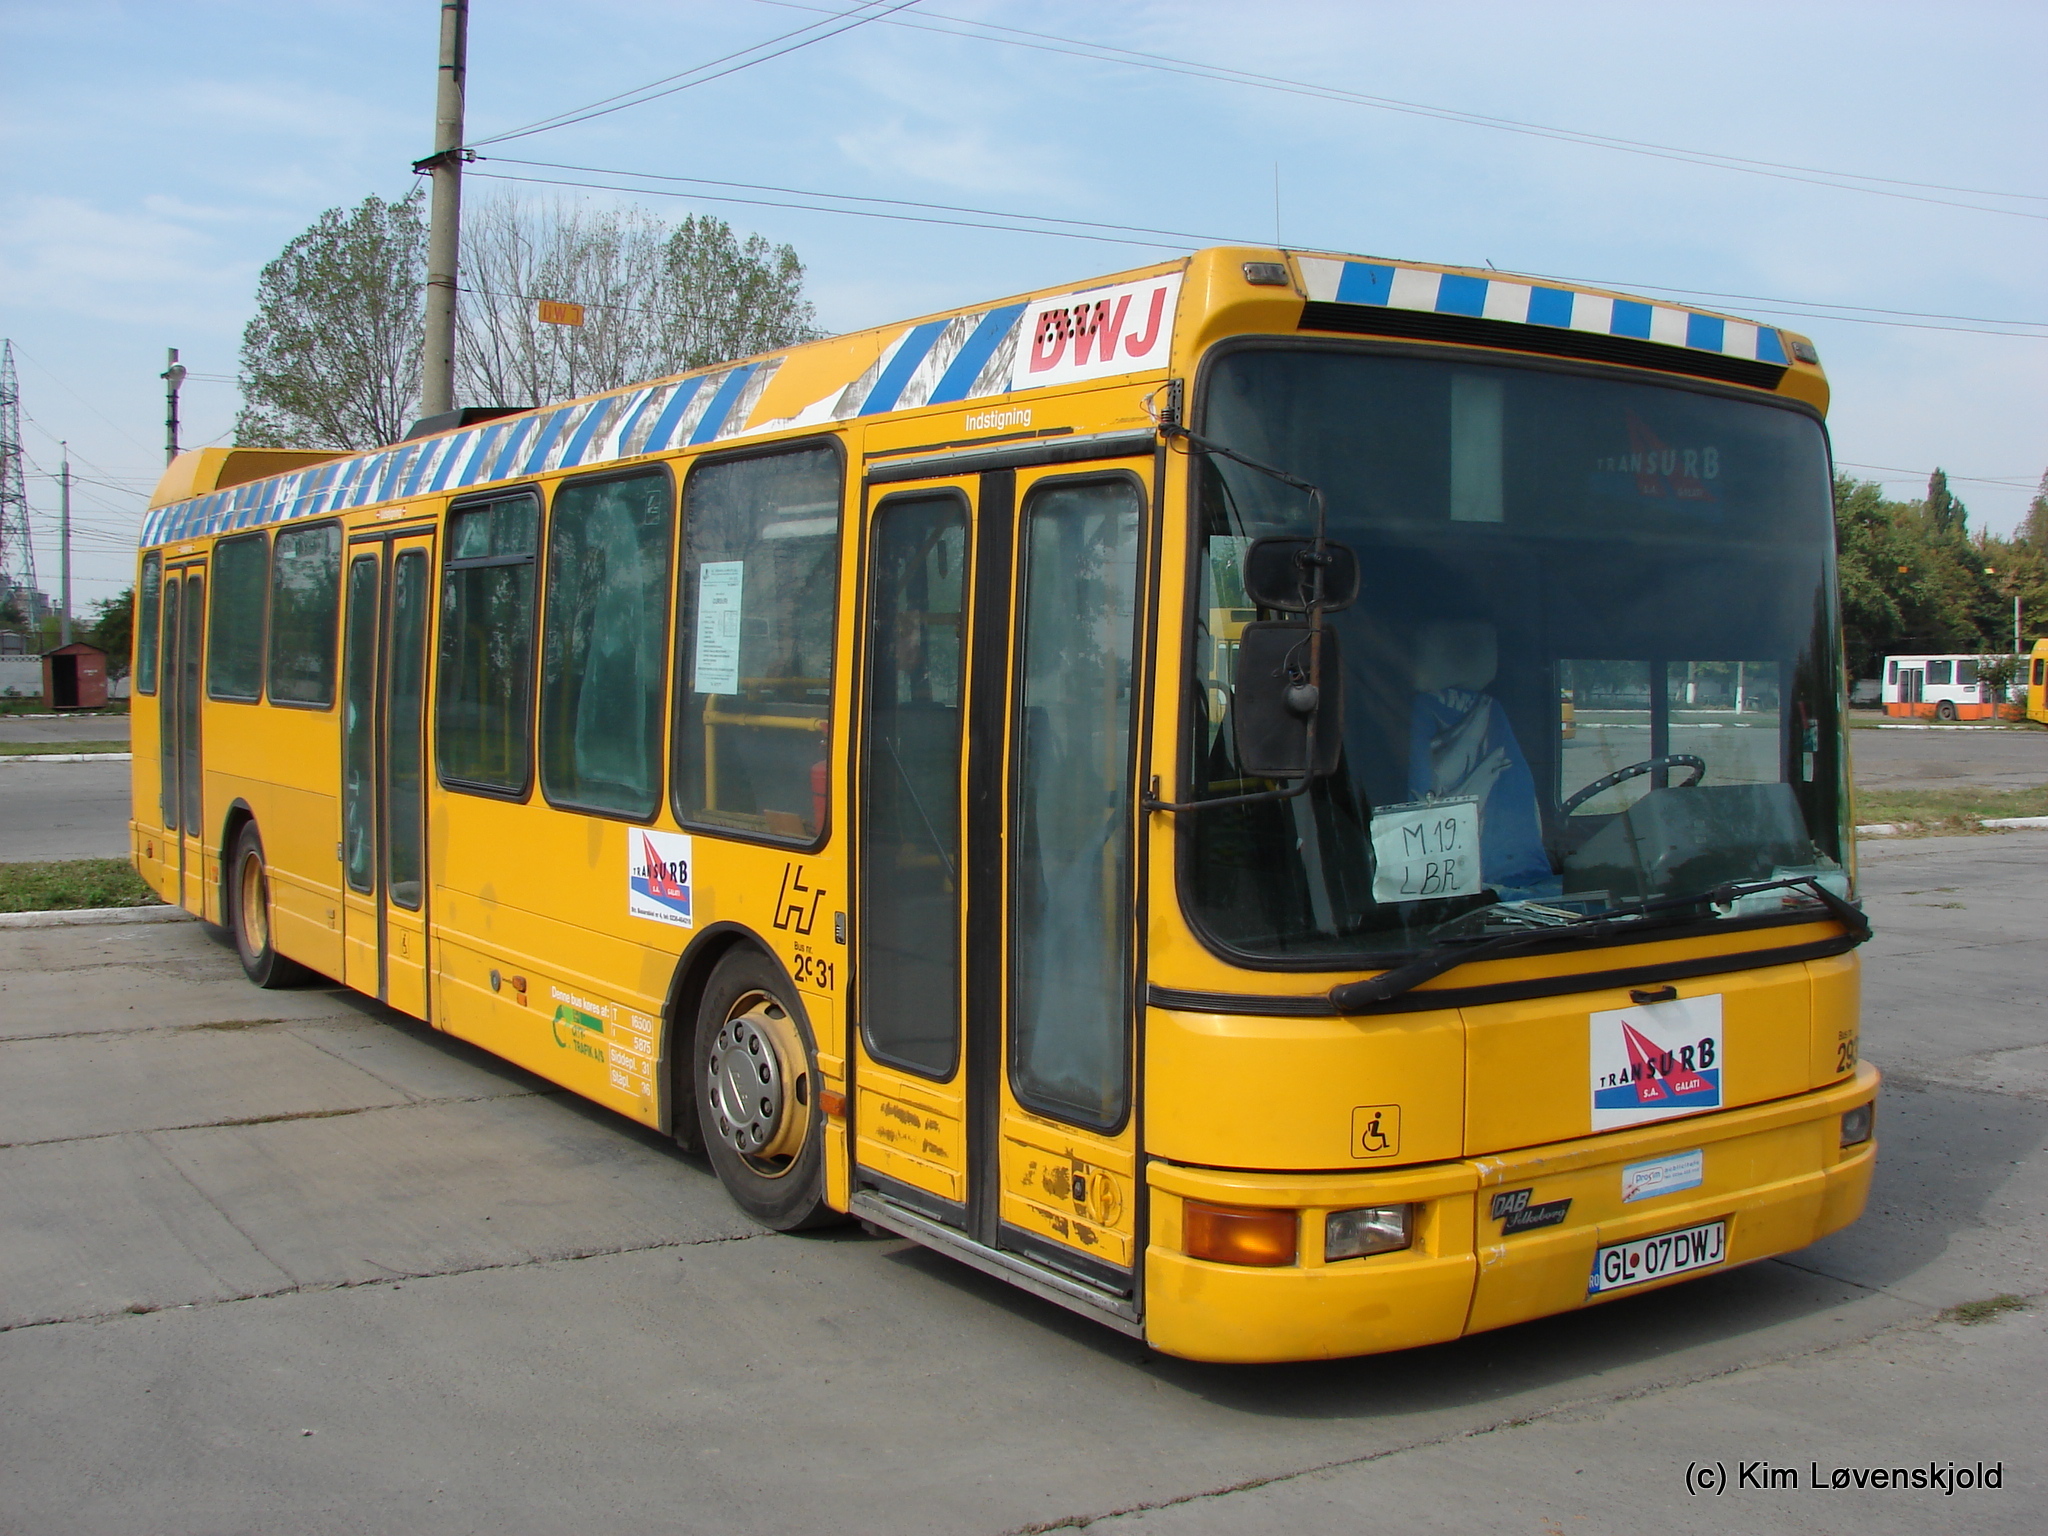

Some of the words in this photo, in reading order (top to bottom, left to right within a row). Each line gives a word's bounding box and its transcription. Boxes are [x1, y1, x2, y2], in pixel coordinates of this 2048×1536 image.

[1029, 286, 1167, 373] DWJ
[965, 408, 1032, 431] Indstigning
[1597, 446, 1720, 480] TRANSURB
[633, 860, 688, 884] TRANSURB
[1600, 1037, 1715, 1087] TRANSURB
[1643, 1087, 1659, 1098] S.A.
[1675, 1080, 1700, 1092] GALATI
[1494, 1191, 1530, 1218] DAB
[1604, 1249, 1635, 1284] GL
[1645, 1226, 1722, 1275] 07DWJ
[1588, 1273, 1600, 1288] RO
